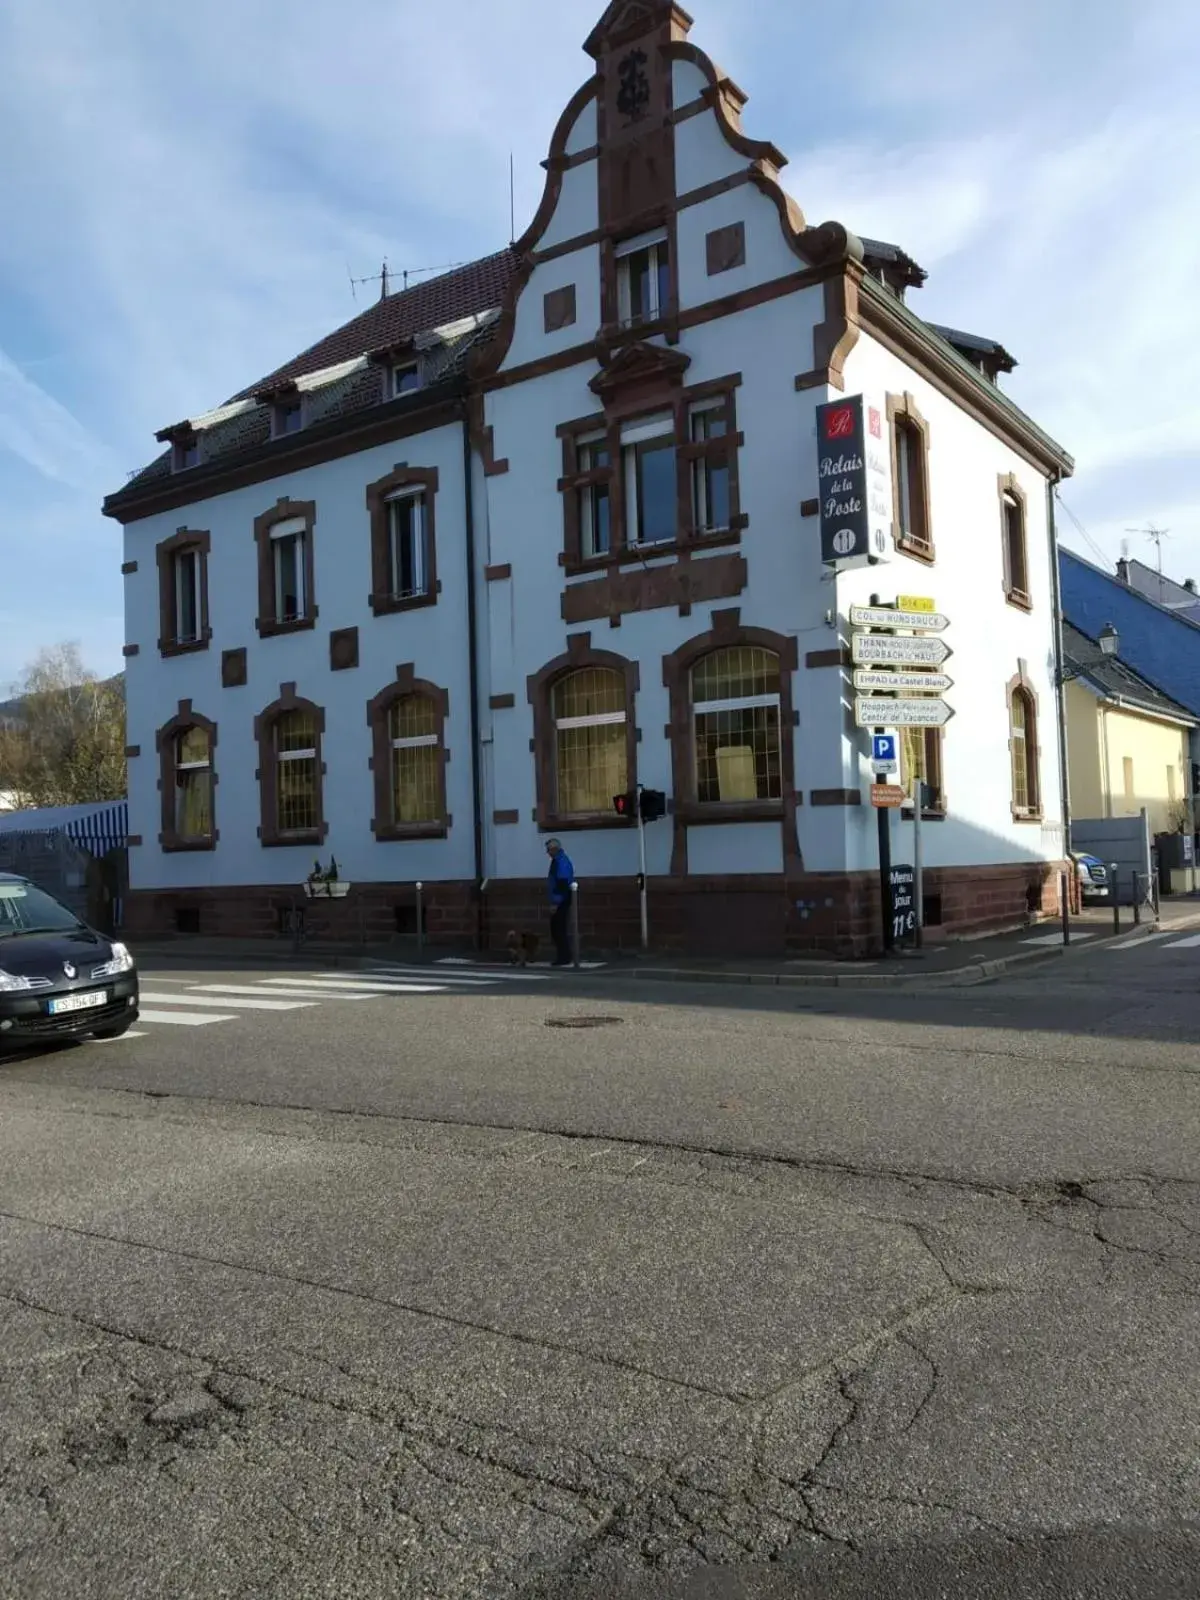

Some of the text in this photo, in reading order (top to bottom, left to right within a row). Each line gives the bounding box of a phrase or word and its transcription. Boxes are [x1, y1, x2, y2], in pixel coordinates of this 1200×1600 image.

[820, 454, 863, 478] Relais
[831, 478, 853, 494] de la
[824, 497, 861, 519] Poste
[856, 612, 875, 620] COL
[859, 638, 887, 648] THANN
[859, 649, 904, 660] BOURBACH
[914, 652, 936, 661] HAUT
[860, 675, 889, 684] EHPAD
[900, 676, 924, 685] Castel
[861, 712, 939, 722] Centre de Vacances
[878, 739, 889, 756] P
[890, 870, 913, 885] Menu
[894, 895, 912, 910] jour
